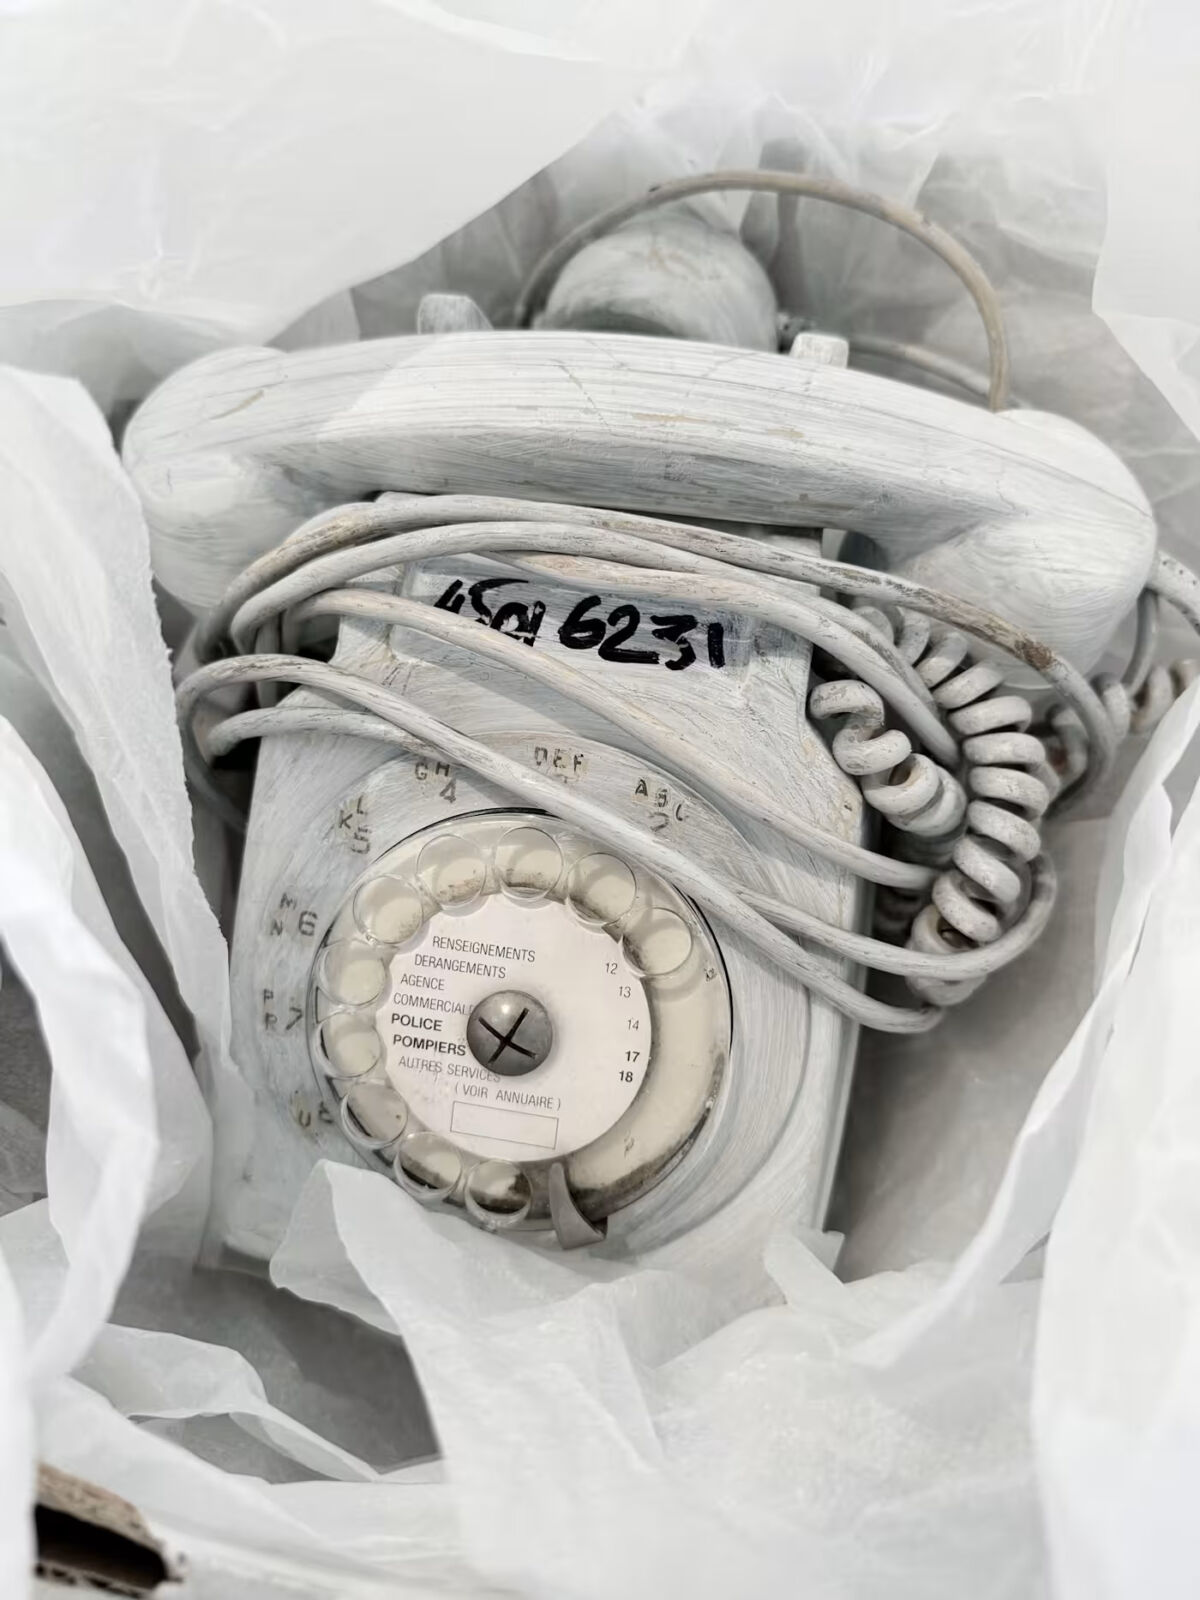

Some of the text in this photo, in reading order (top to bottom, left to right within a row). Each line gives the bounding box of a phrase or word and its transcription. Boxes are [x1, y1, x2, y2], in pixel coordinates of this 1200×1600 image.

[557, 595, 726, 671] 6231
[298, 910, 318, 936] 6
[432, 935, 536, 963] RENSEIGNEMENTS
[414, 953, 507, 979] DERANGEMENTS
[604, 961, 619, 976] 12
[400, 973, 446, 991] AGENCE
[618, 985, 632, 999] 13
[285, 1006, 303, 1031] 7
[391, 1012, 443, 1032] POLICE
[626, 1018, 640, 1031] 14
[393, 1034, 467, 1056] POMPIERS
[398, 1056, 443, 1073] AUTRES
[624, 1050, 641, 1064] 17
[618, 1070, 634, 1084] 18
